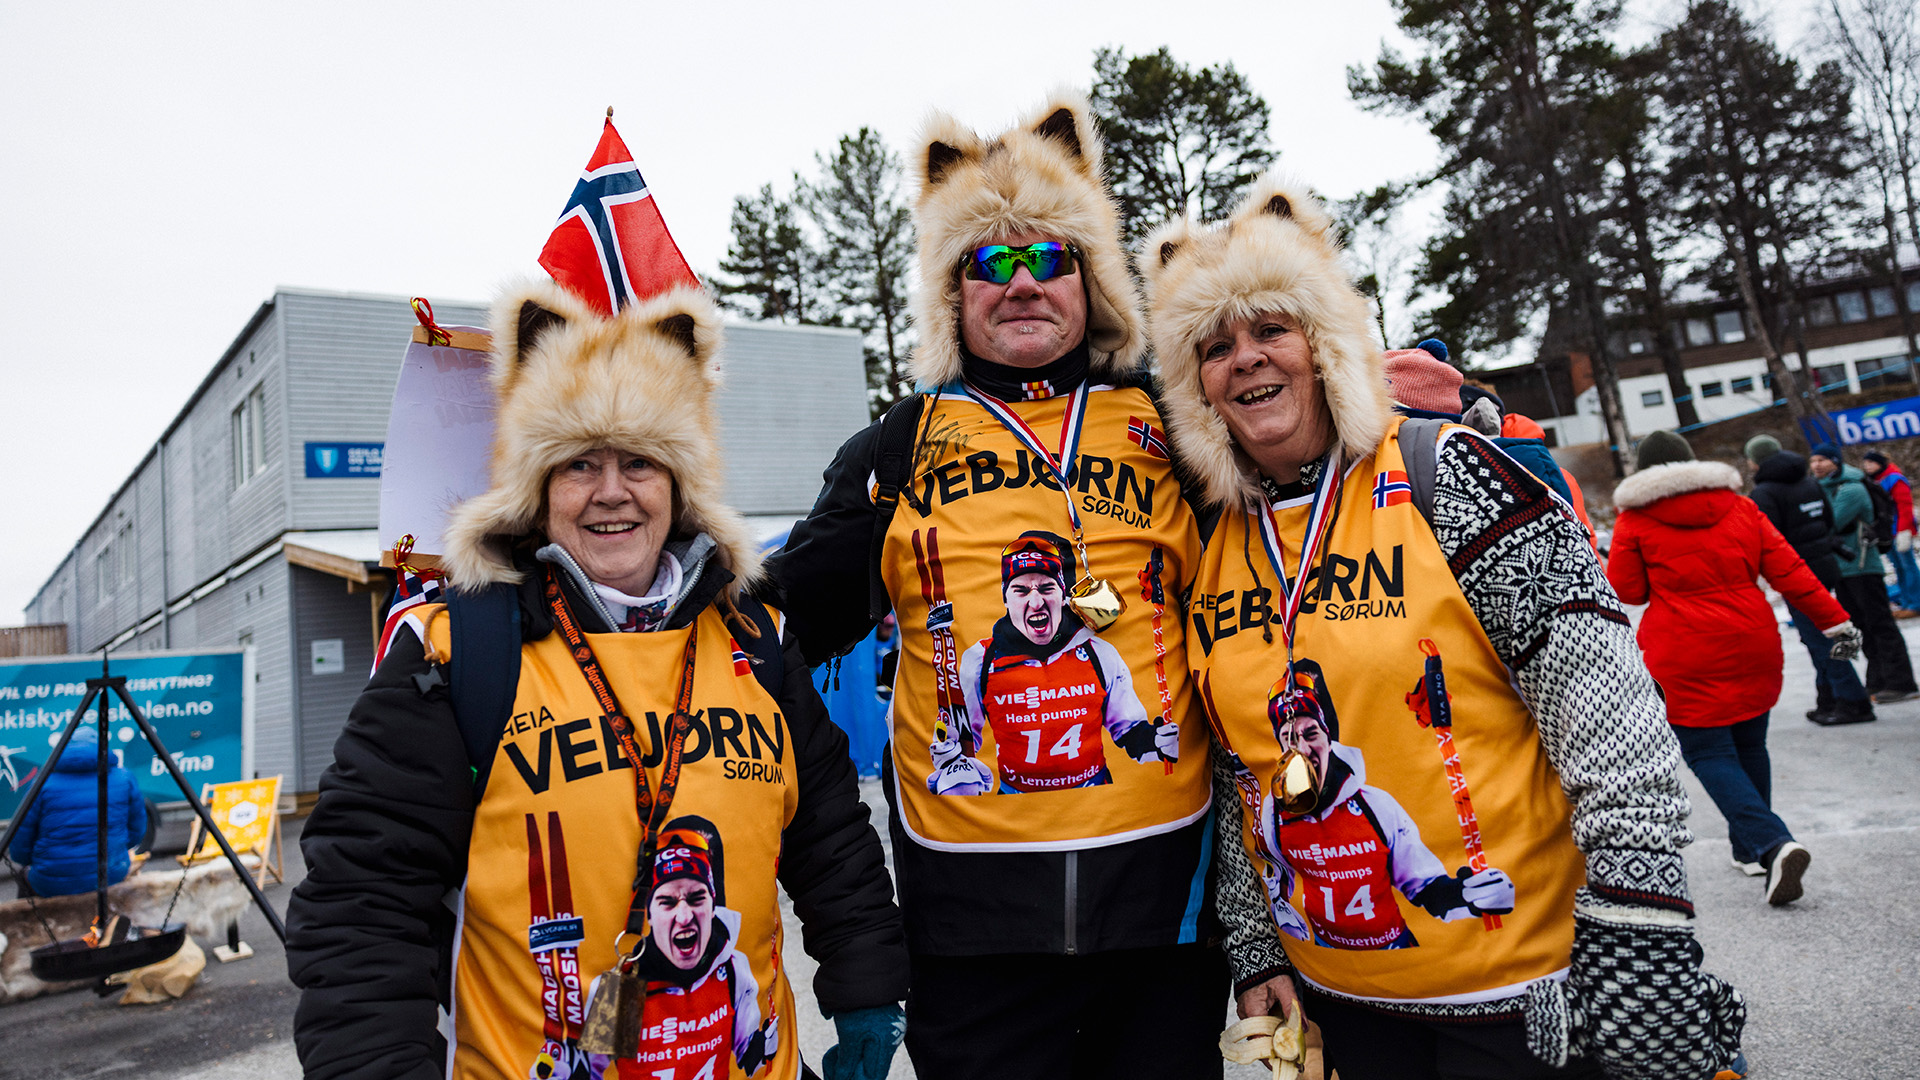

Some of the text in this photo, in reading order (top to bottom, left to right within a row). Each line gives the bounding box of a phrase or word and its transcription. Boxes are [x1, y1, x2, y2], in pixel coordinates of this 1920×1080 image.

[901, 449, 1155, 518] VEBJØRN
[1081, 495, 1151, 529] SØRUM
[1324, 599, 1407, 621] SØRUM
[24, 684, 50, 699] DU
[53, 682, 88, 697] PRØ
[994, 683, 1096, 709] VIESSMANN
[1005, 707, 1088, 724] Heat pumps
[503, 707, 785, 795] VEBJØRN
[1020, 723, 1083, 764] 14
[151, 755, 214, 776] bma
[723, 760, 785, 786] SØRUM
[1288, 840, 1377, 866] VIESSMANN
[1329, 867, 1373, 882] pumps
[1319, 884, 1376, 923] 14
[642, 1004, 728, 1044] IESSMANN
[637, 1035, 722, 1063] Heat pumps
